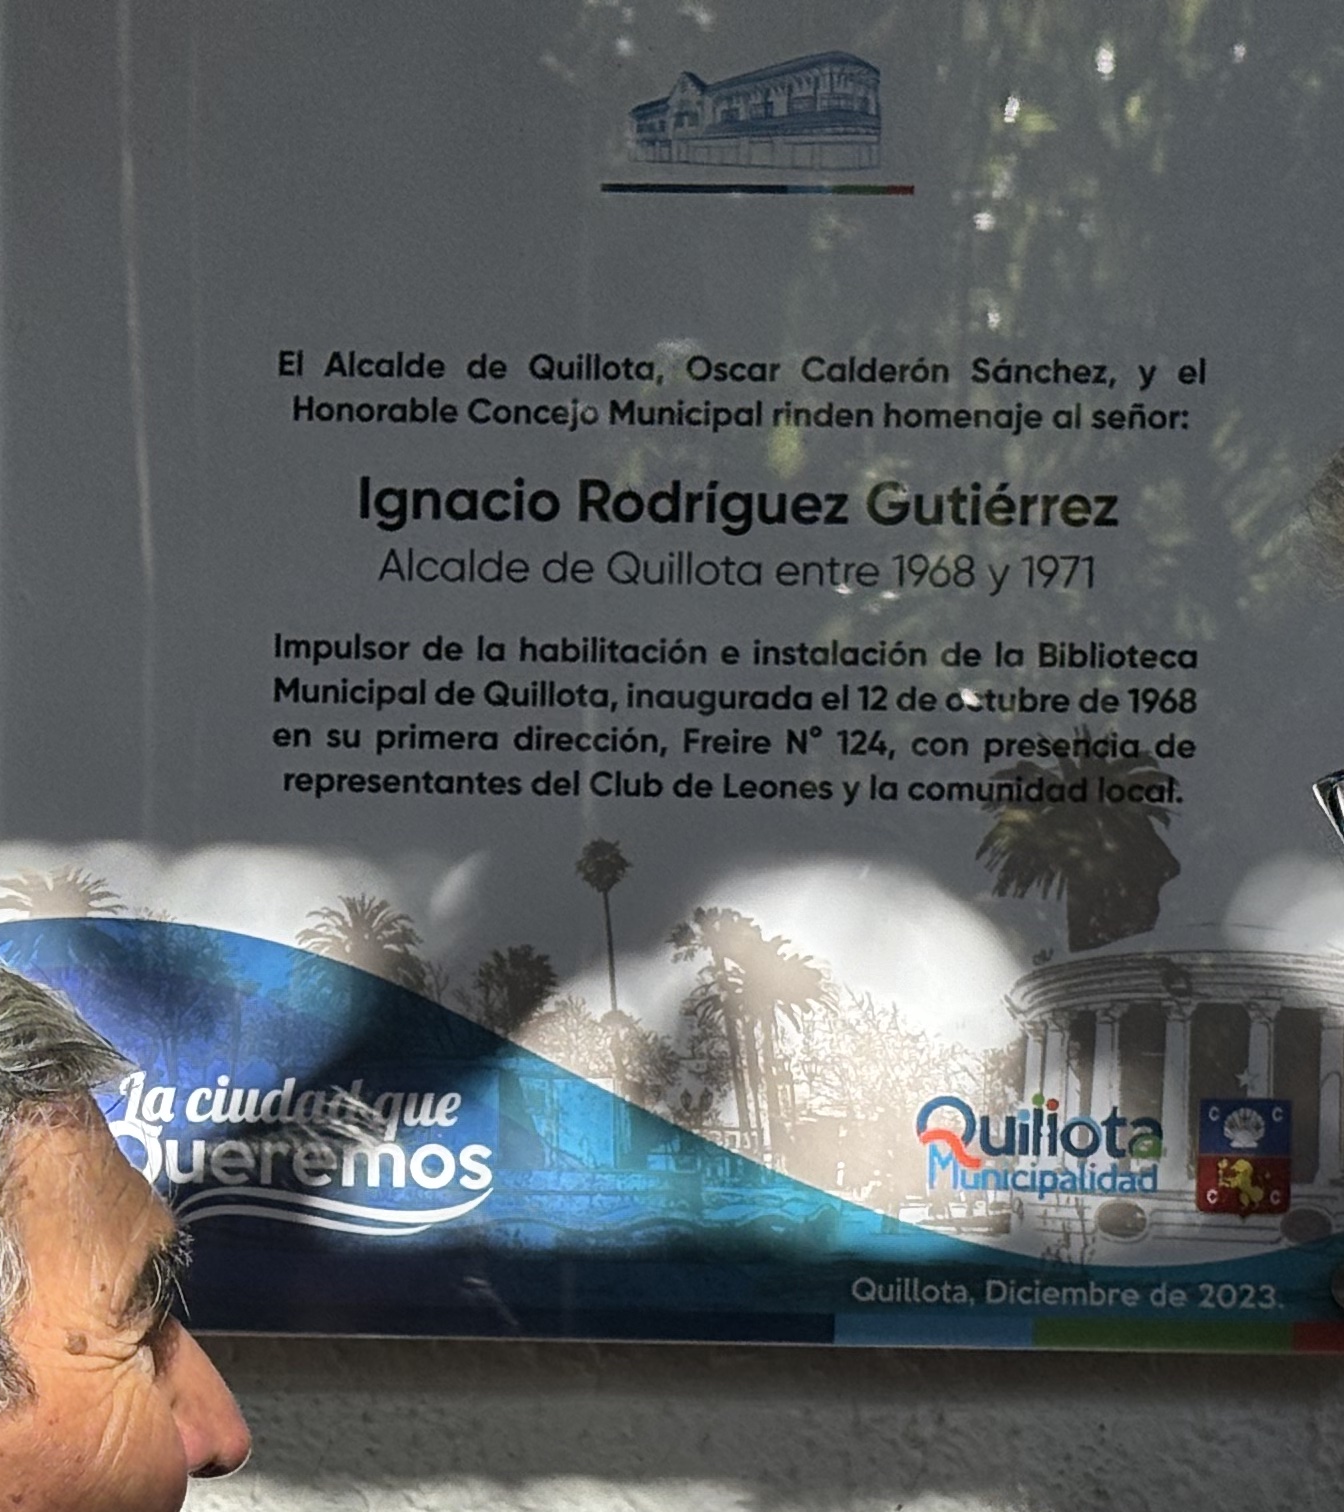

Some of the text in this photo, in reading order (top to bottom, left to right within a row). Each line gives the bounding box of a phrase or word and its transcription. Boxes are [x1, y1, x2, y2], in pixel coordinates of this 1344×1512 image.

[278, 350, 1206, 389] El Alcalde de Quillota, Oscar Calderón Sánchez, y el
[292, 396, 1189, 436] Honorable Concejo Municipal rinden homenaje al señor:
[359, 476, 1119, 535] Ignacio Rodríguez Gutiérrez
[378, 548, 1095, 596] Alcalde de Quillota entre 1968 y 1971
[273, 633, 1198, 669] Impulsor de la habilitación e instalación de la Biblioteca
[273, 678, 1197, 716] Municipal de Quillota, inaugurada el 12 de octubre de 1968
[273, 728, 311, 747] en
[326, 728, 360, 748] su
[376, 724, 498, 754] primera
[513, 726, 667, 757] dirección,
[683, 729, 771, 755] Freire
[837, 730, 895, 760] 124,
[911, 737, 968, 757] con
[984, 733, 1140, 763] presencia
[1155, 733, 1195, 758] de
[284, 771, 1182, 806] representantes del Club de Leones y la comunidad local.
[119, 1070, 461, 1141] La ciudad que
[916, 1094, 1163, 1167] Quillota
[109, 1120, 493, 1189] Queremos
[928, 1145, 1157, 1199] Municipalidad
[851, 1278, 974, 1305] Quillota,
[986, 1280, 1138, 1306] Diciembre
[1150, 1283, 1187, 1307] de
